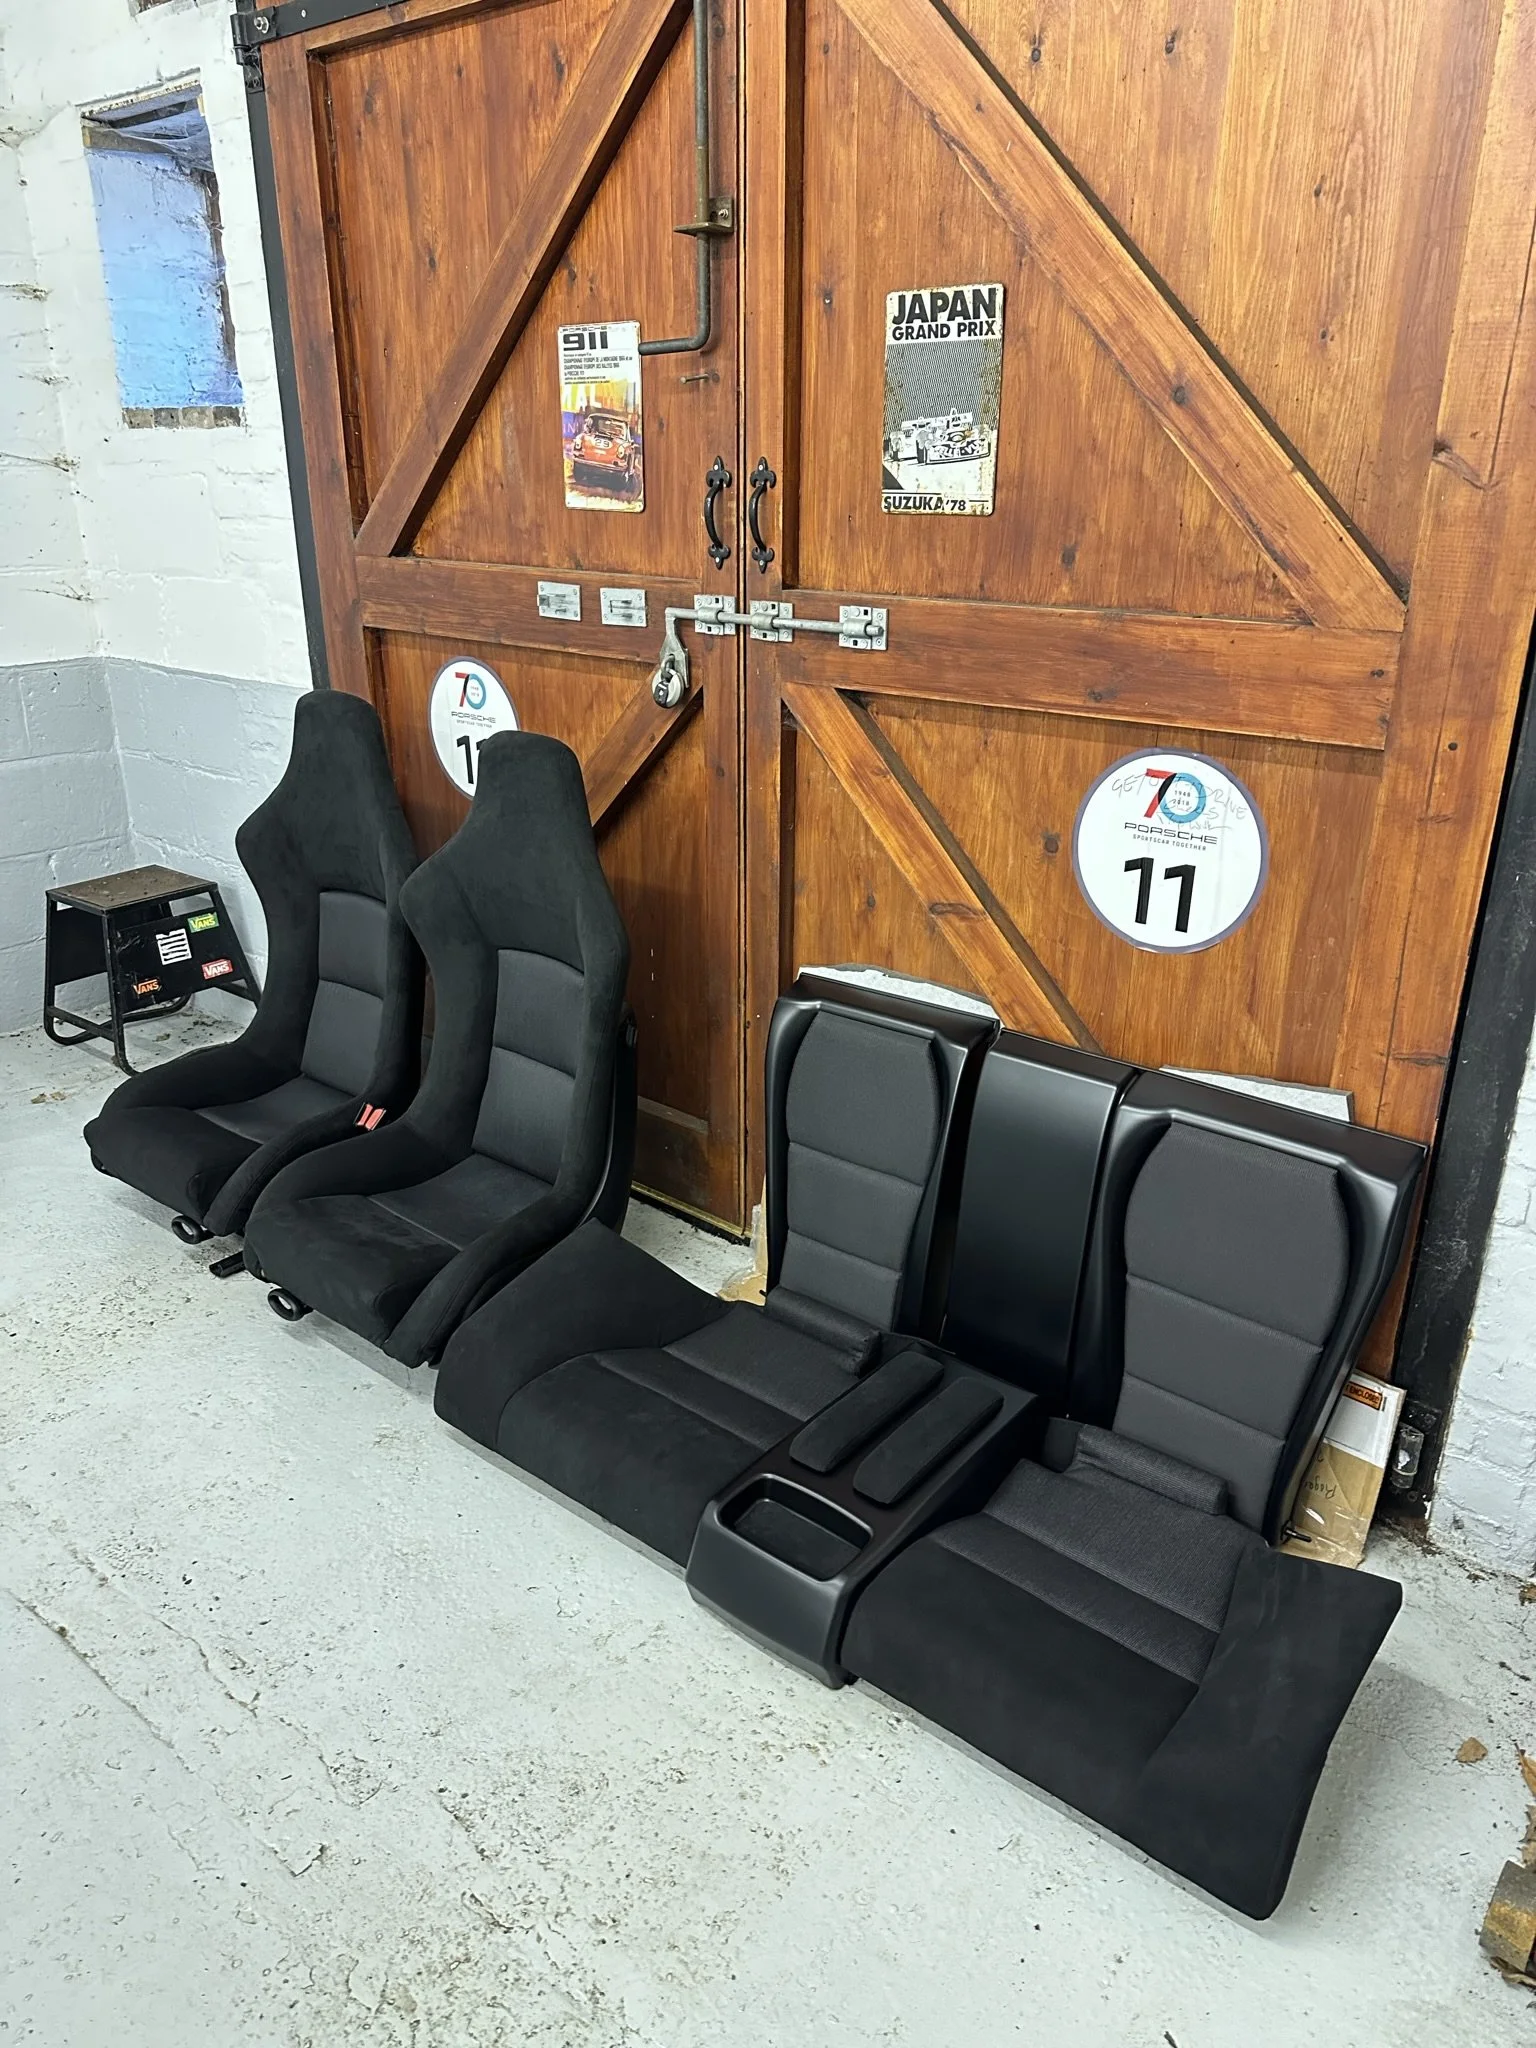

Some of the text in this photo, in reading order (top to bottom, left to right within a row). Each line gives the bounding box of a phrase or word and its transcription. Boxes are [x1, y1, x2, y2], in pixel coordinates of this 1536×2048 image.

[892, 287, 997, 326] JAPAN
[563, 331, 608, 351] 911
[892, 320, 996, 342] GRAND PRIX
[884, 496, 966, 511] SUZUKA '78
[455, 672, 486, 710] 70
[450, 711, 496, 724] PORSCHE
[1144, 768, 1206, 823] 70
[1124, 822, 1218, 845] PORSCHE
[1132, 834, 1207, 852] SPORTSCAR TOGETHER
[1123, 857, 1196, 933] 11
[190, 913, 216, 930] VANS
[204, 960, 230, 977] VANS
[133, 978, 162, 995] VANS
